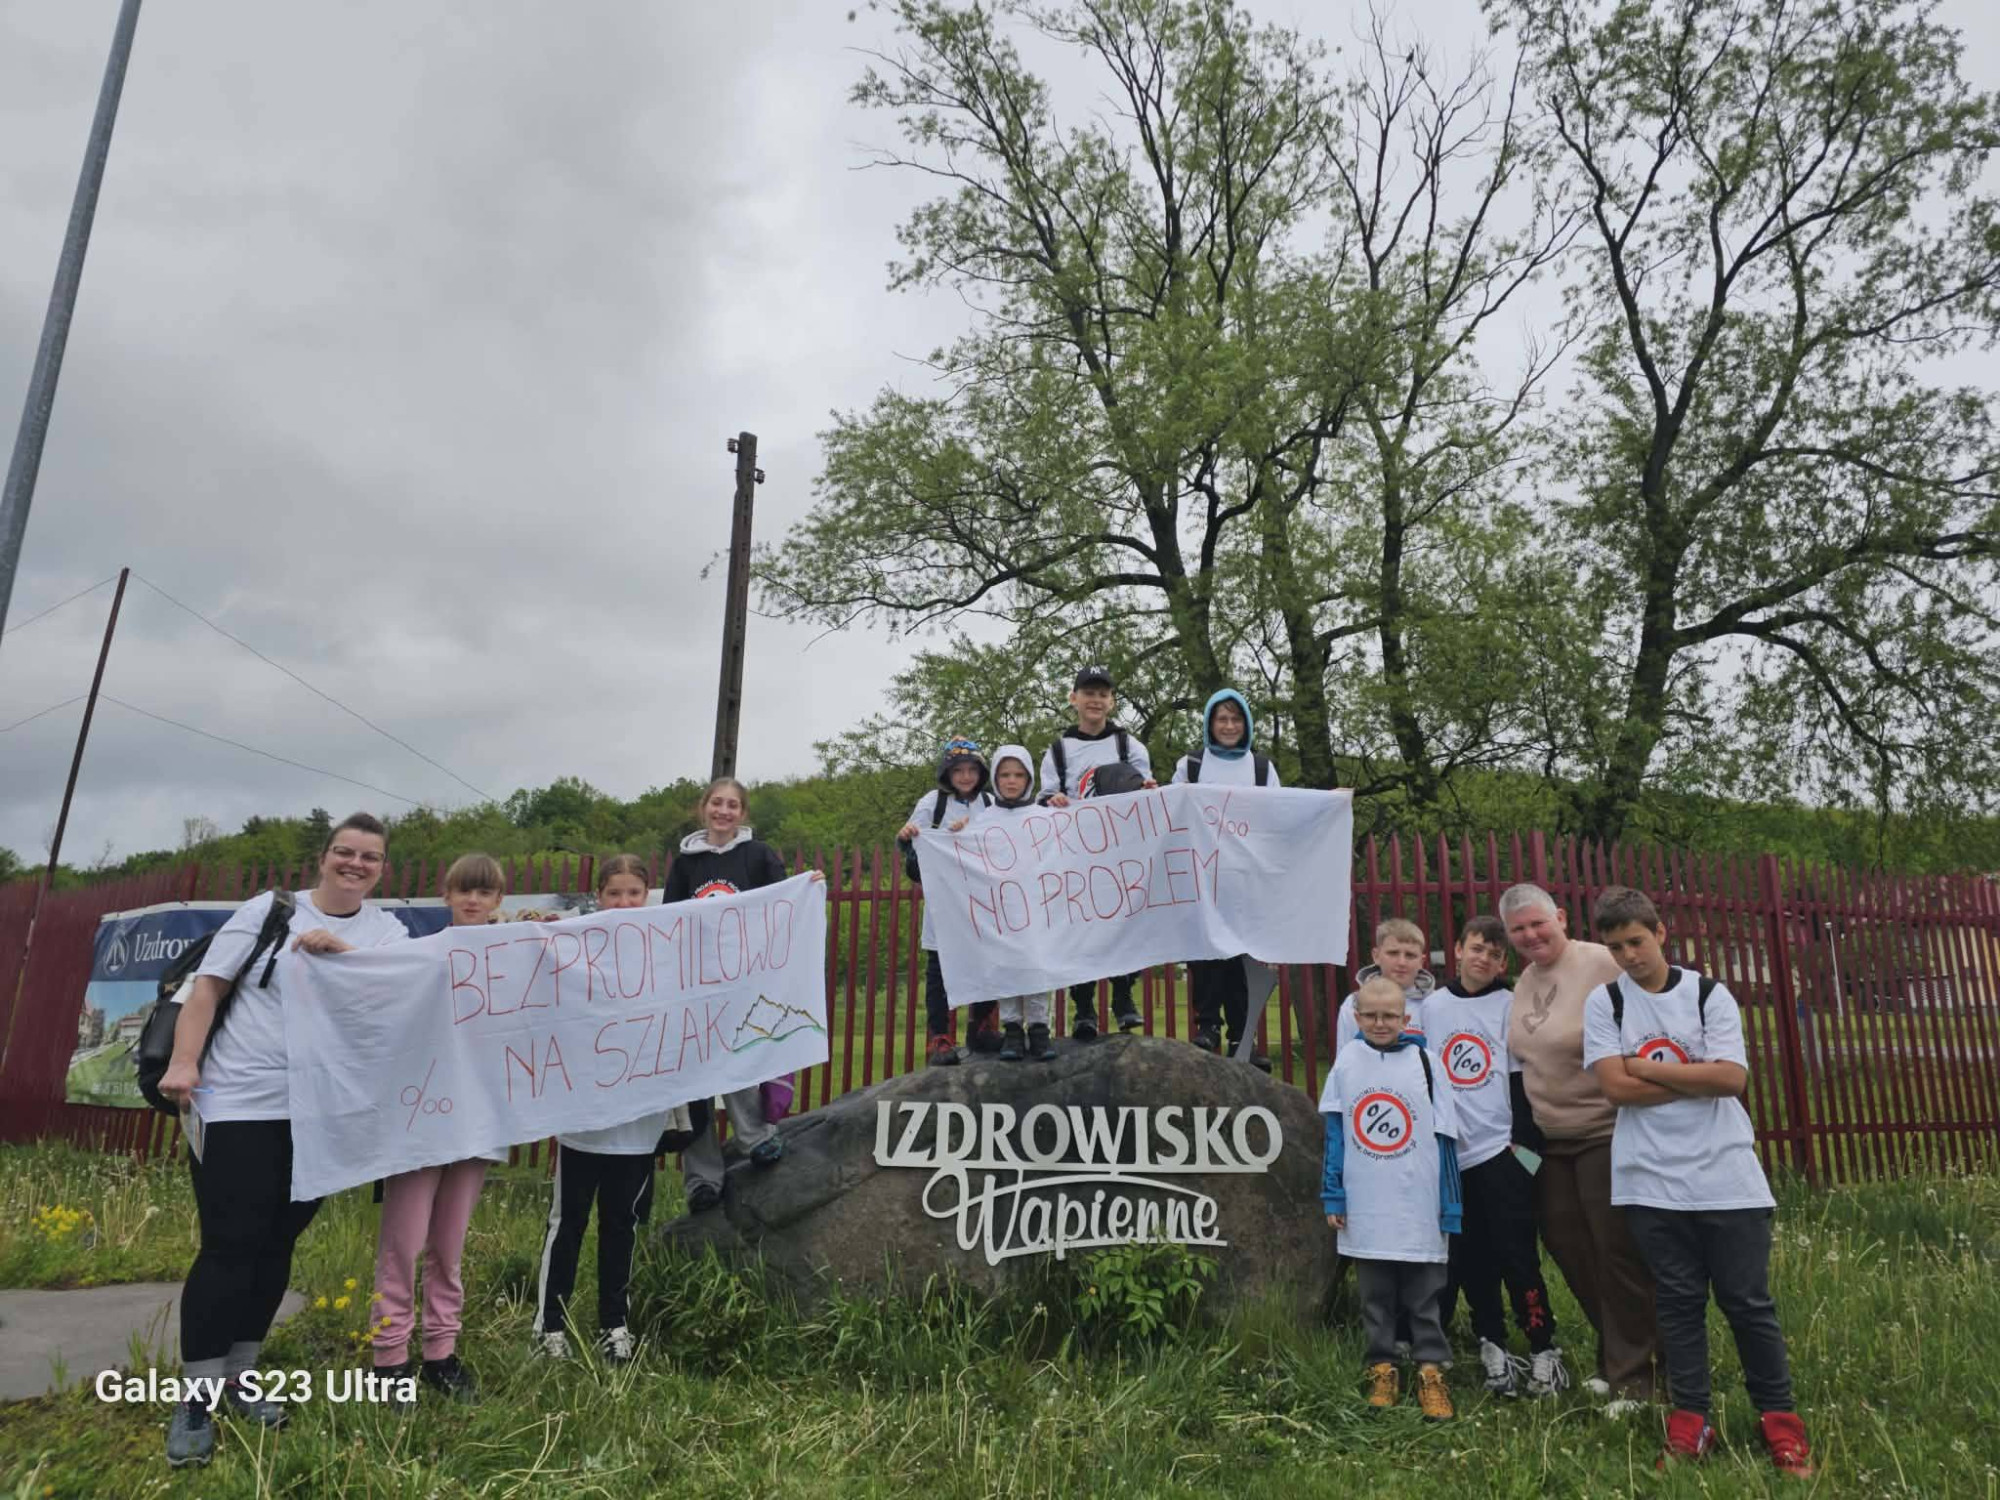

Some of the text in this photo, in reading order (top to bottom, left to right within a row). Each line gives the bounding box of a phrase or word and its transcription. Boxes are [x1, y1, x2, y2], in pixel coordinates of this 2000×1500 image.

[954, 826, 1017, 881] NO
[1022, 791, 1189, 861] PROMIL
[969, 848, 1219, 938] NO PROBLEM
[135, 930, 196, 962] Uzdro
[448, 899, 794, 1025] BEZPROMILOWO
[505, 1000, 731, 1102] NA SZLAK
[922, 1167, 1228, 1266] Wapienne
